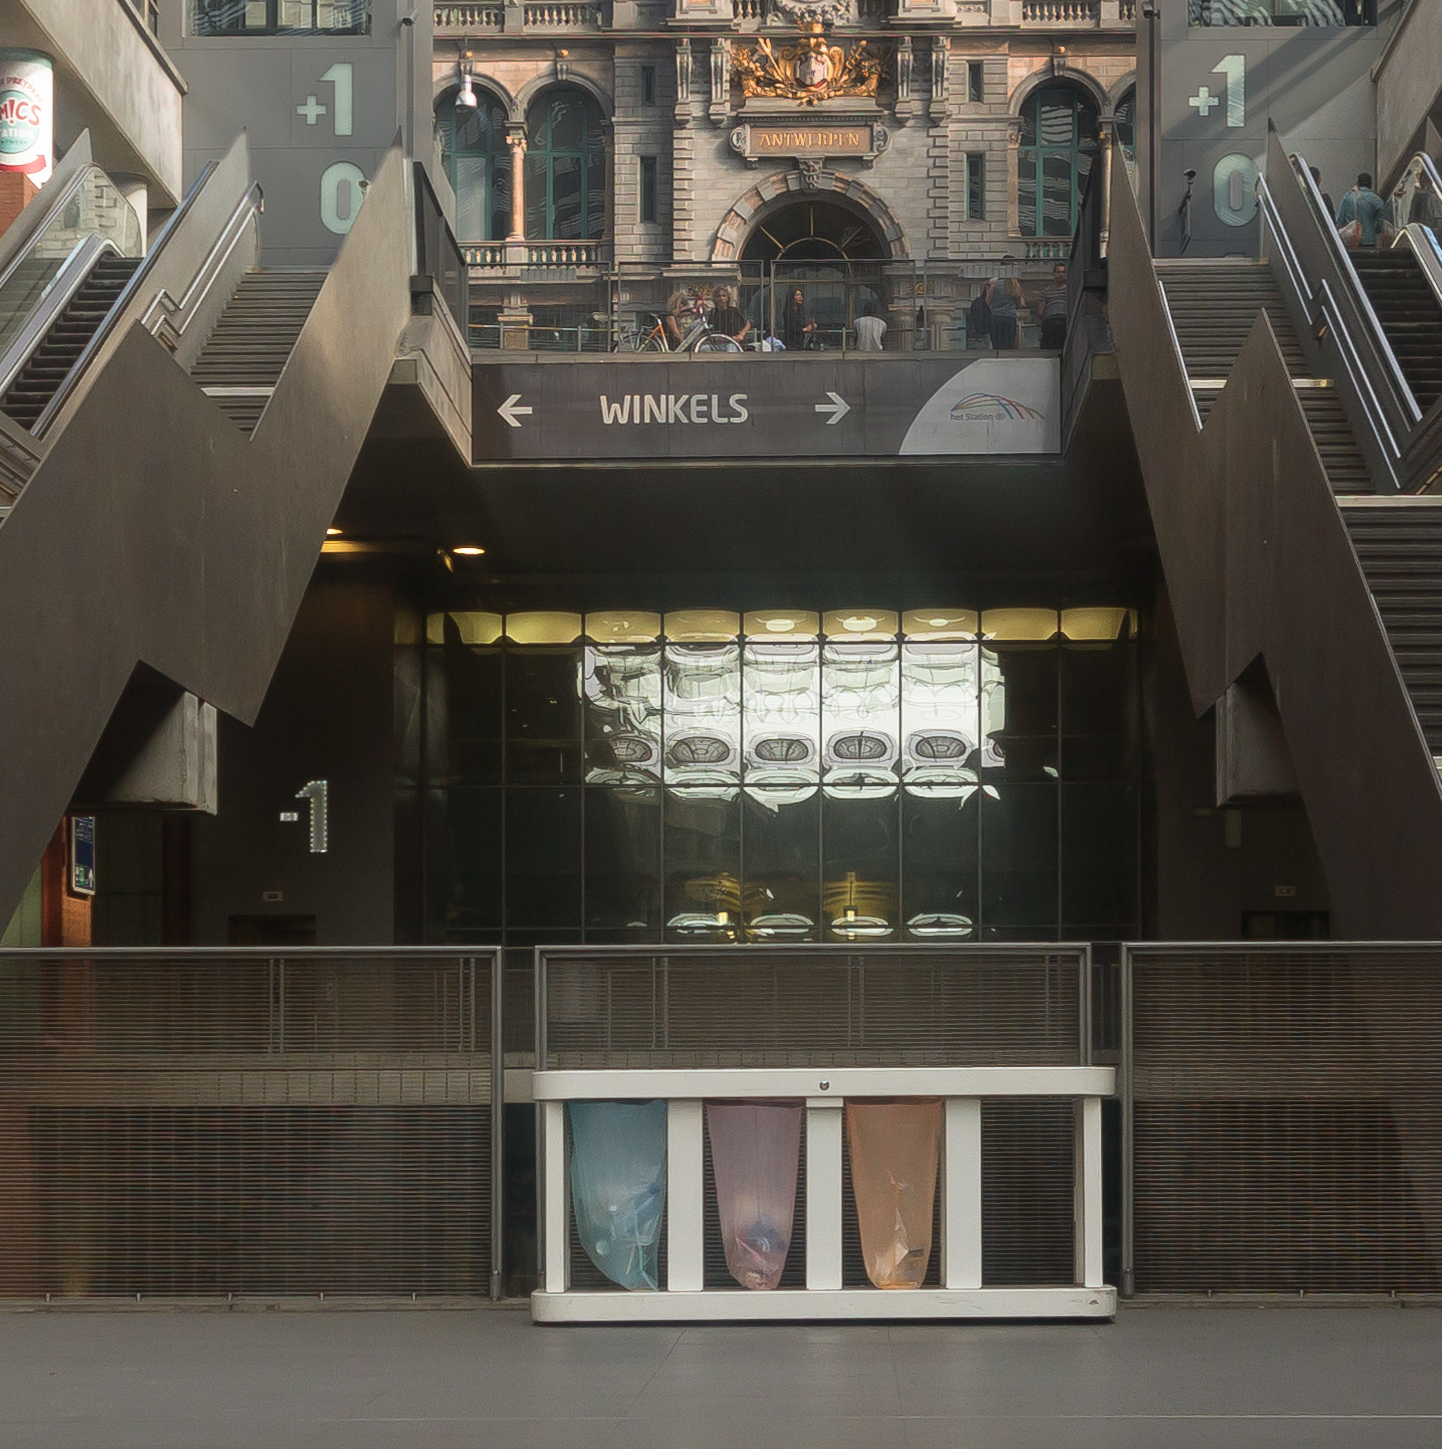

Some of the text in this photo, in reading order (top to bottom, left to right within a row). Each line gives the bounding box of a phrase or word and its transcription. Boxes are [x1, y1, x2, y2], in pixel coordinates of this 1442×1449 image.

[296, 62, 353, 136] +1
[1188, 54, 1246, 128] +1
[759, 132, 859, 146] ANTWERPEN
[320, 162, 367, 235] 0
[1213, 153, 1259, 228] 0
[599, 393, 749, 425] WINKELS
[279, 779, 328, 853] -1
